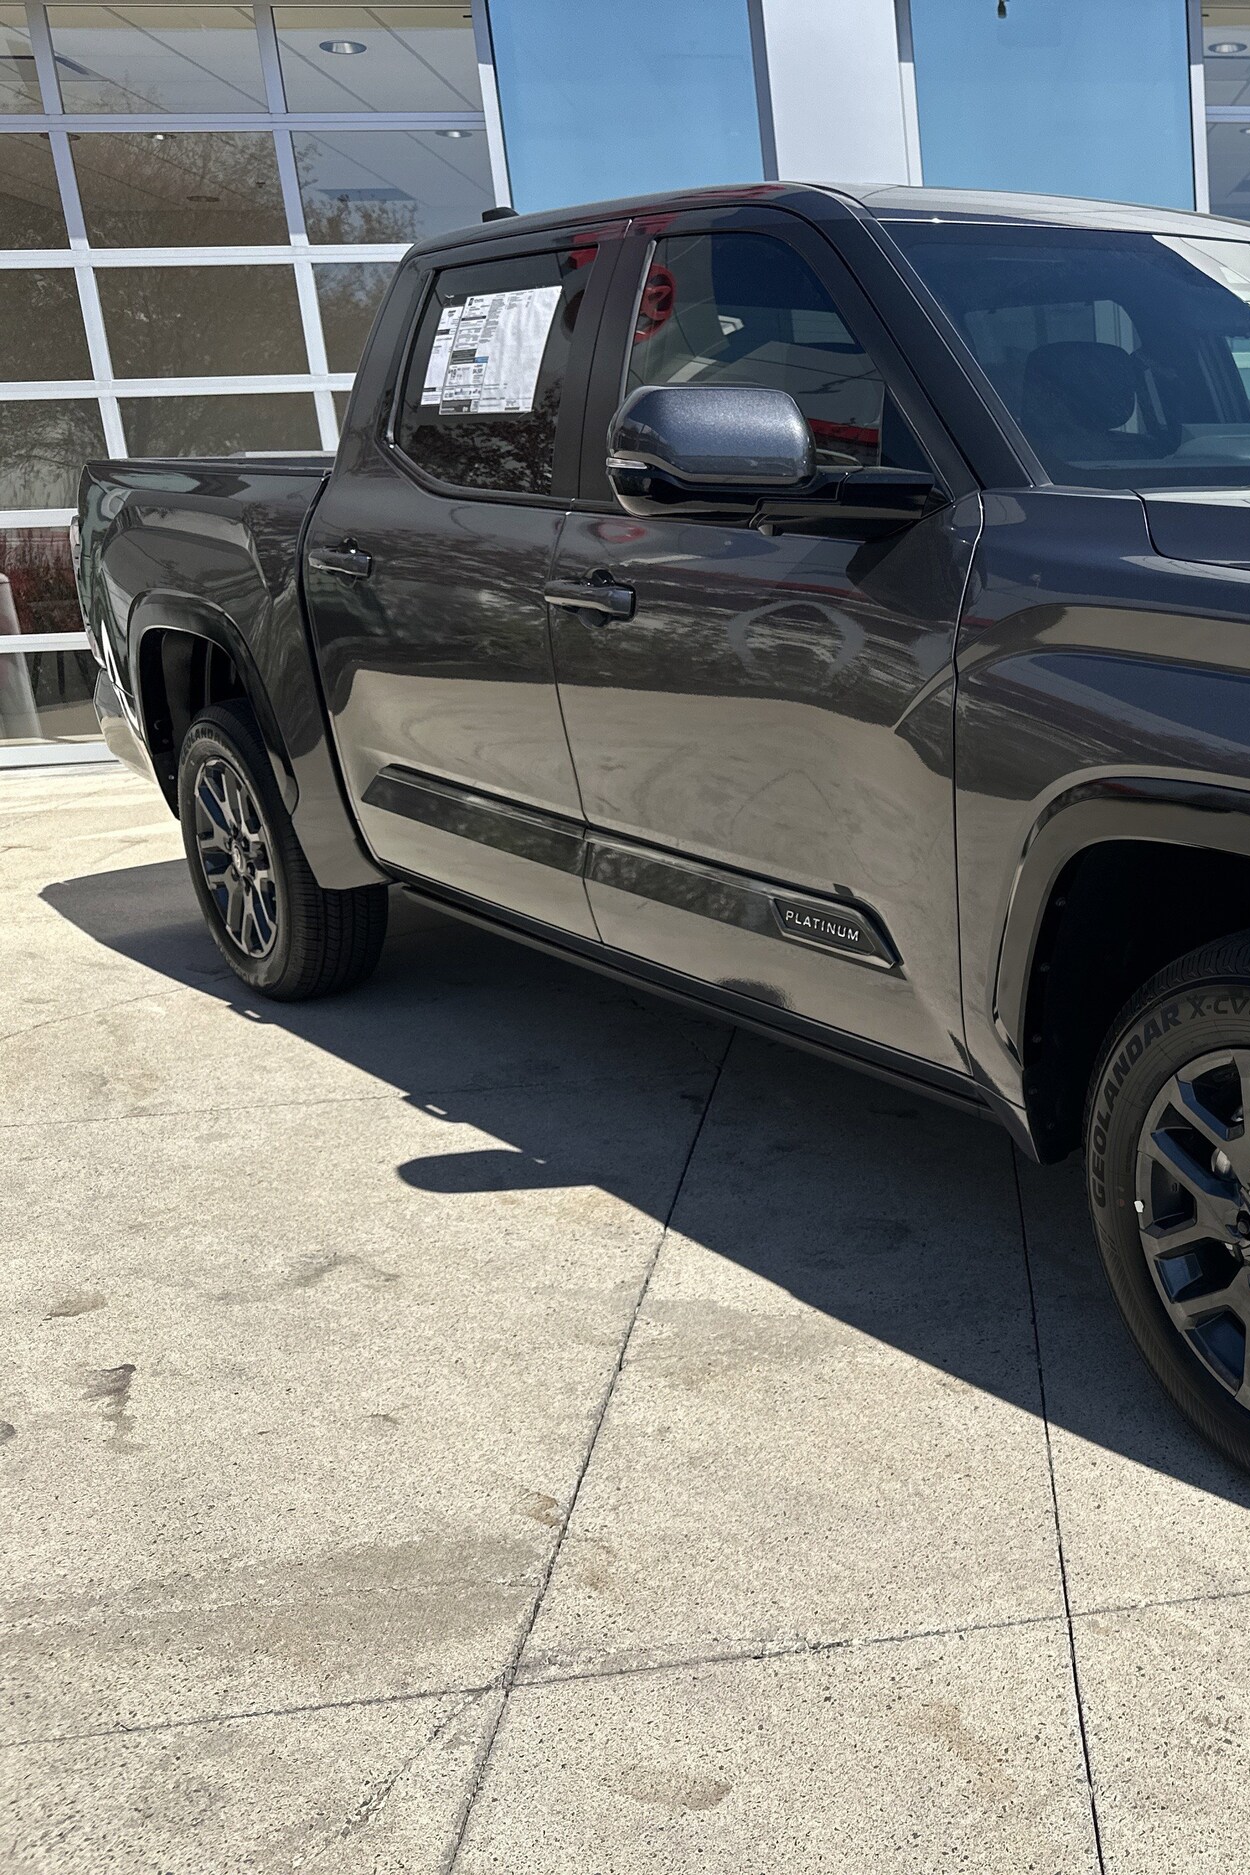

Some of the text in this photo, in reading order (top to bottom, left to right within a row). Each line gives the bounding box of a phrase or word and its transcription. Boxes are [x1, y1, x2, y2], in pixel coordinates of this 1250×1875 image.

[785, 910, 859, 942] PLATINUM
[1091, 1002, 1182, 1208] GEOLANDAR
[1186, 994, 1250, 1020] X-CV
